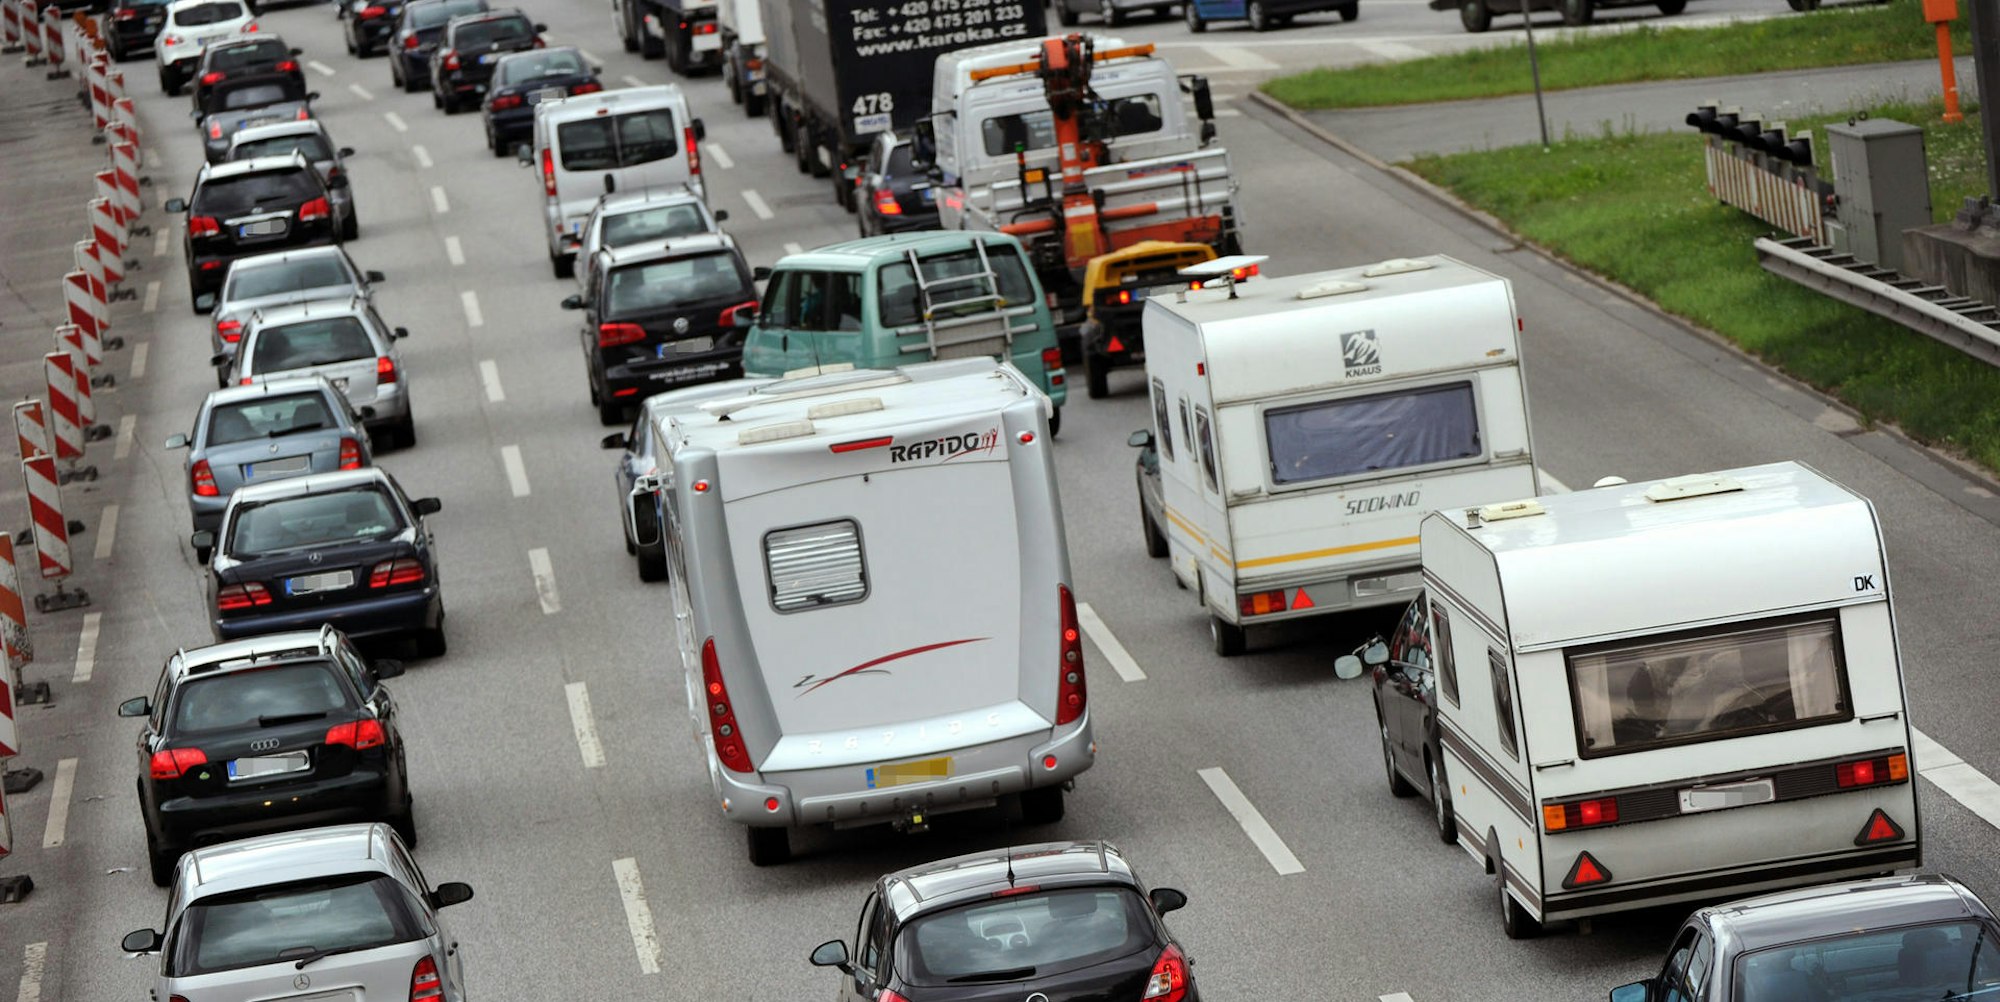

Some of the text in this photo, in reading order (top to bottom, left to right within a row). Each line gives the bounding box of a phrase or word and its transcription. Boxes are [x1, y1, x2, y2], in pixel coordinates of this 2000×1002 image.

[887, 7, 897, 16] +
[900, 1, 929, 16] 420
[890, 24, 900, 34] +
[903, 17, 931, 33] 420
[933, 13, 962, 29] 475
[963, 9, 992, 25] 201
[995, 5, 1024, 21] 233
[856, 23, 1028, 57] www.kareka.cz
[852, 92, 894, 115] 478
[1345, 364, 1382, 379] KNAUS
[1854, 574, 1876, 592] DK
